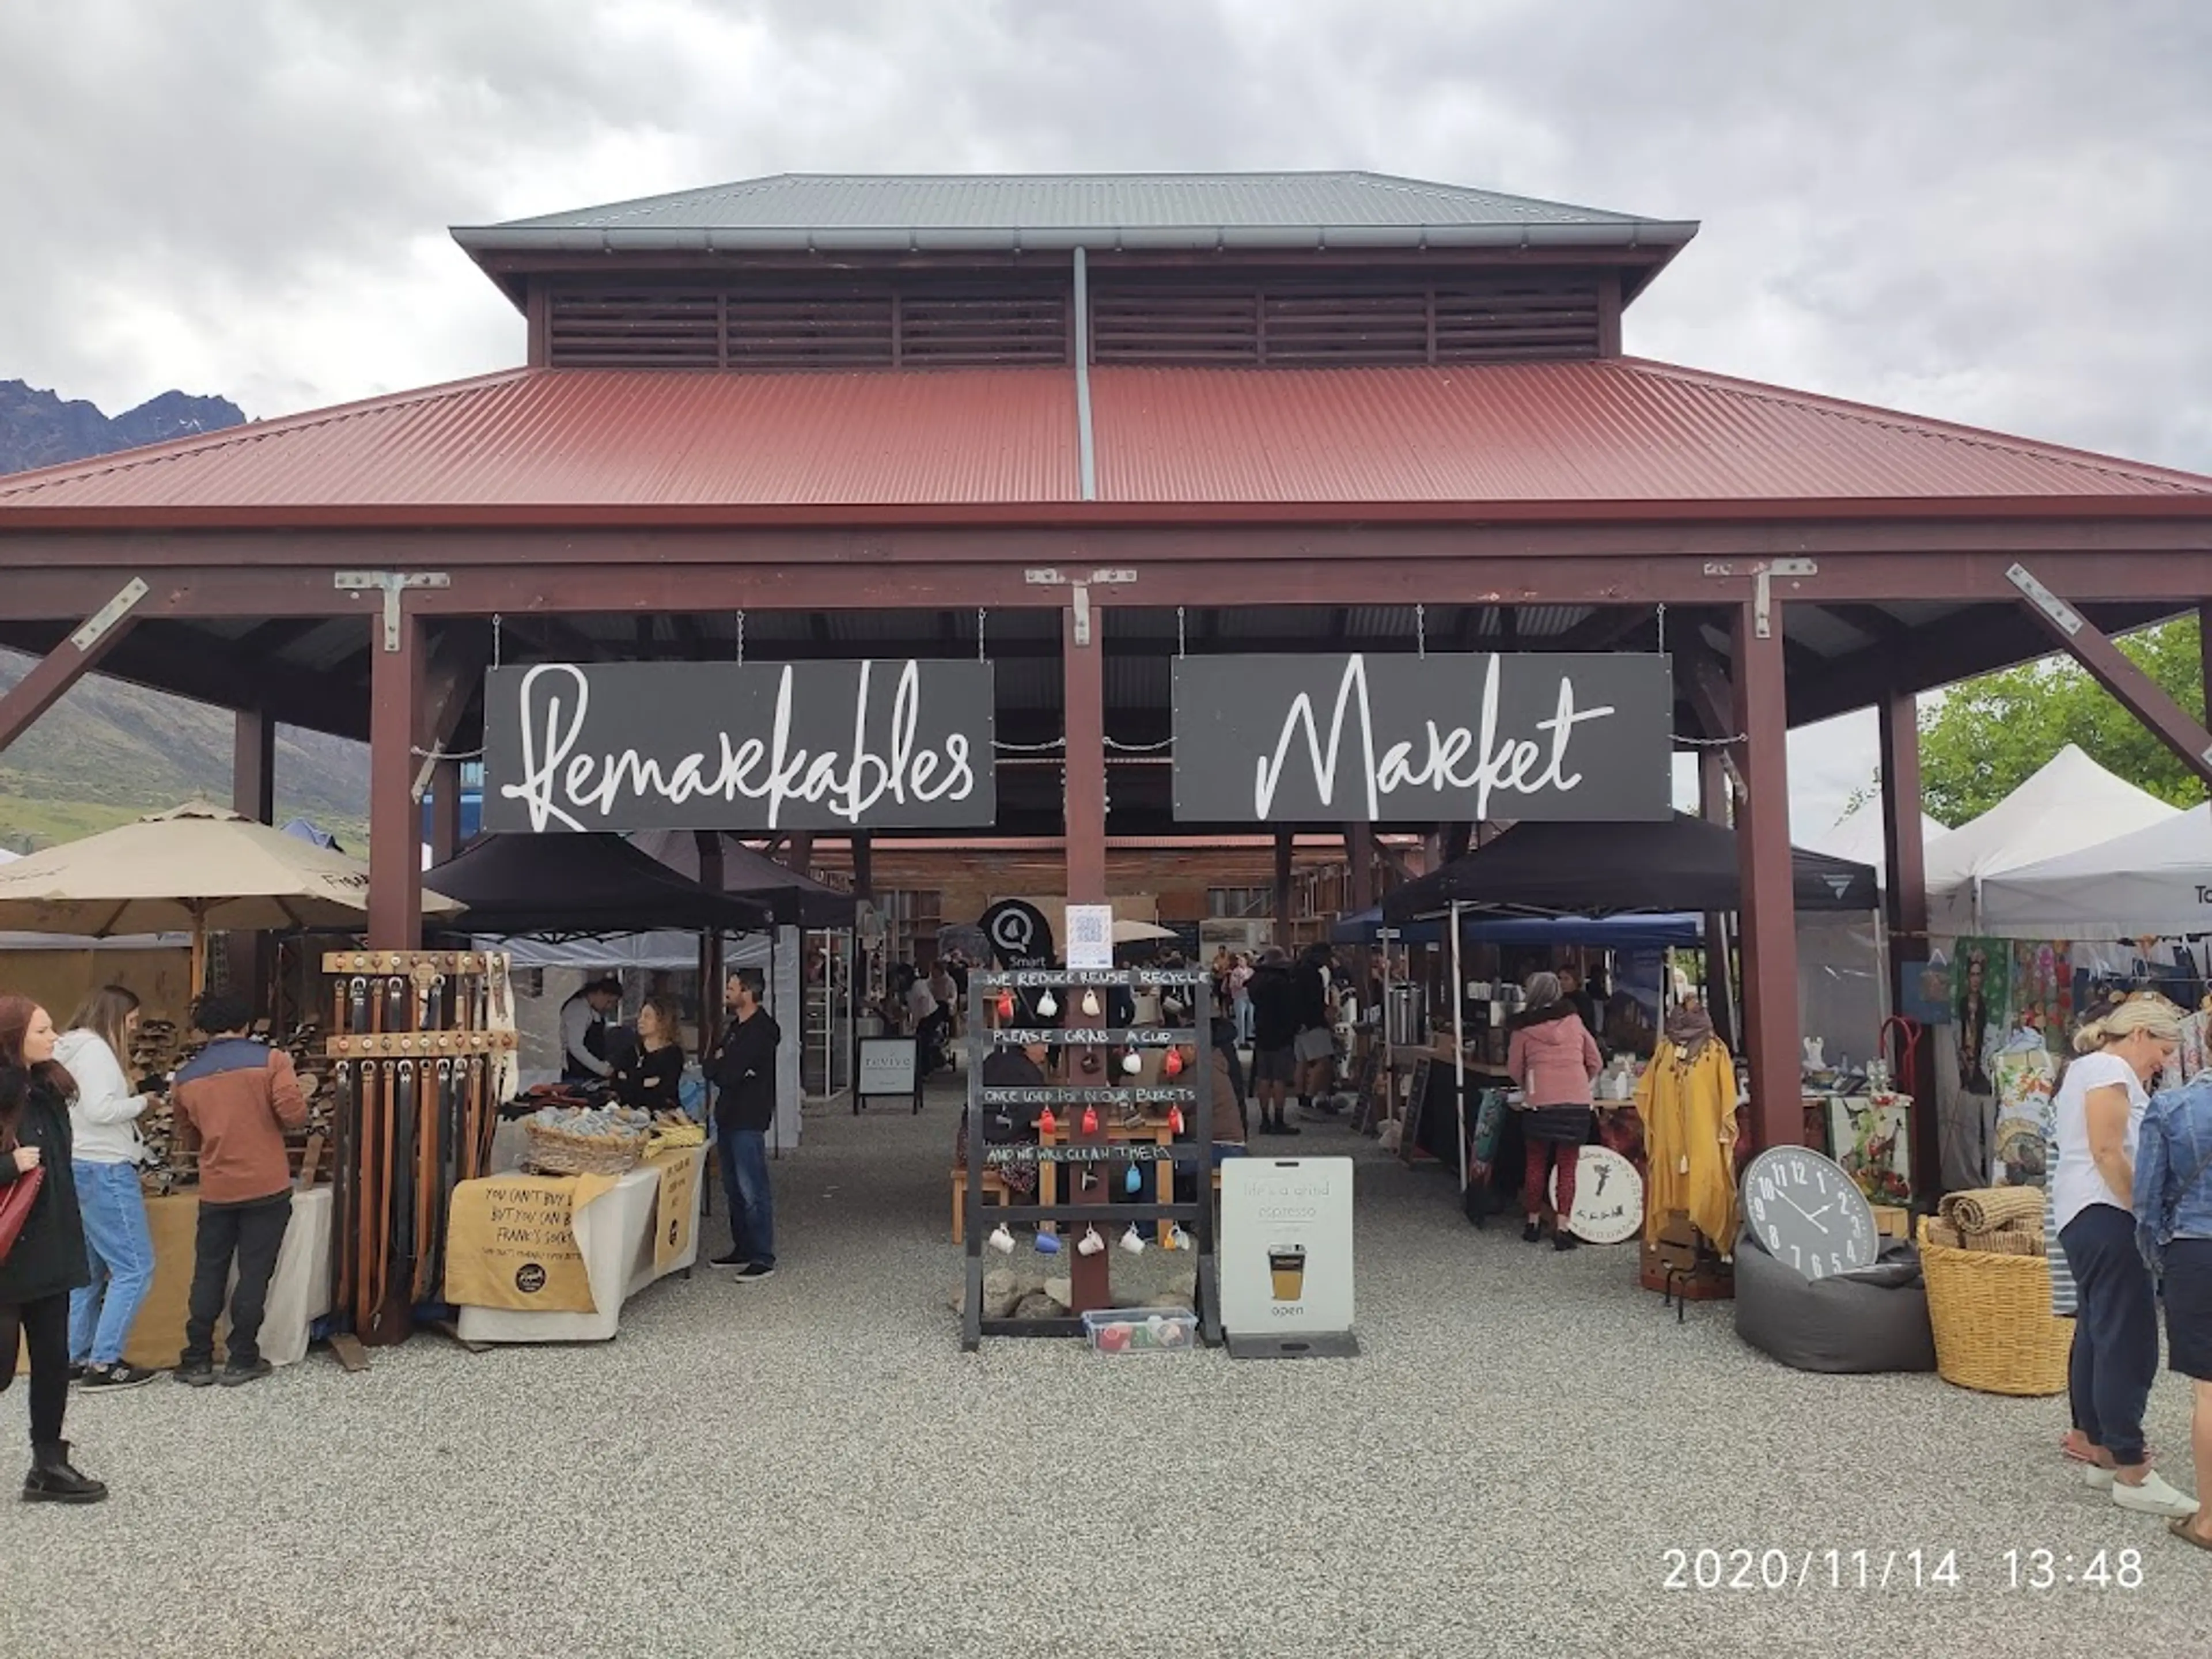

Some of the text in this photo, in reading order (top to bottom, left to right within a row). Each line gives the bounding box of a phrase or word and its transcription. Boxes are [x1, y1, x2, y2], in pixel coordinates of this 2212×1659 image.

[502, 661, 974, 832] Remarkables
[1256, 653, 1614, 820] Market
[986, 971, 1209, 986] WE REDUCE REUSE RECYCLE
[993, 1029, 1172, 1043] PLEASE GRAB A CUP
[984, 1090, 1019, 1103] ONCE
[1023, 1090, 1052, 1102] USED
[1136, 1088, 1195, 1101] BUCKETS
[987, 1147, 1014, 1162] AND
[1067, 1147, 1109, 1160] CLEAN
[1115, 1146, 1171, 1160] THEM
[1771, 1162, 1787, 1187] 11
[1790, 1160, 1808, 1185] 12
[1816, 1171, 1827, 1195] 1
[486, 1188, 506, 1200] YOU
[510, 1188, 543, 1204] CAN'T
[544, 1192, 565, 1206] BUY
[1758, 1176, 1776, 1202] 10
[1258, 1207, 1317, 1219] espresso
[1754, 1196, 1766, 1222] 9
[1838, 1191, 1851, 1215] 2
[491, 1206, 515, 1222] BUT
[514, 1210, 537, 1224] YOU
[540, 1211, 560, 1225] CAN
[1851, 1215, 1861, 1239] 3
[1768, 1224, 1781, 1250] 8
[1790, 1244, 1801, 1271] 7
[1831, 1252, 1842, 1274] 5
[1846, 1240, 1857, 1263] 4
[1811, 1252, 1824, 1279] 6
[1271, 1305, 1304, 1319] open
